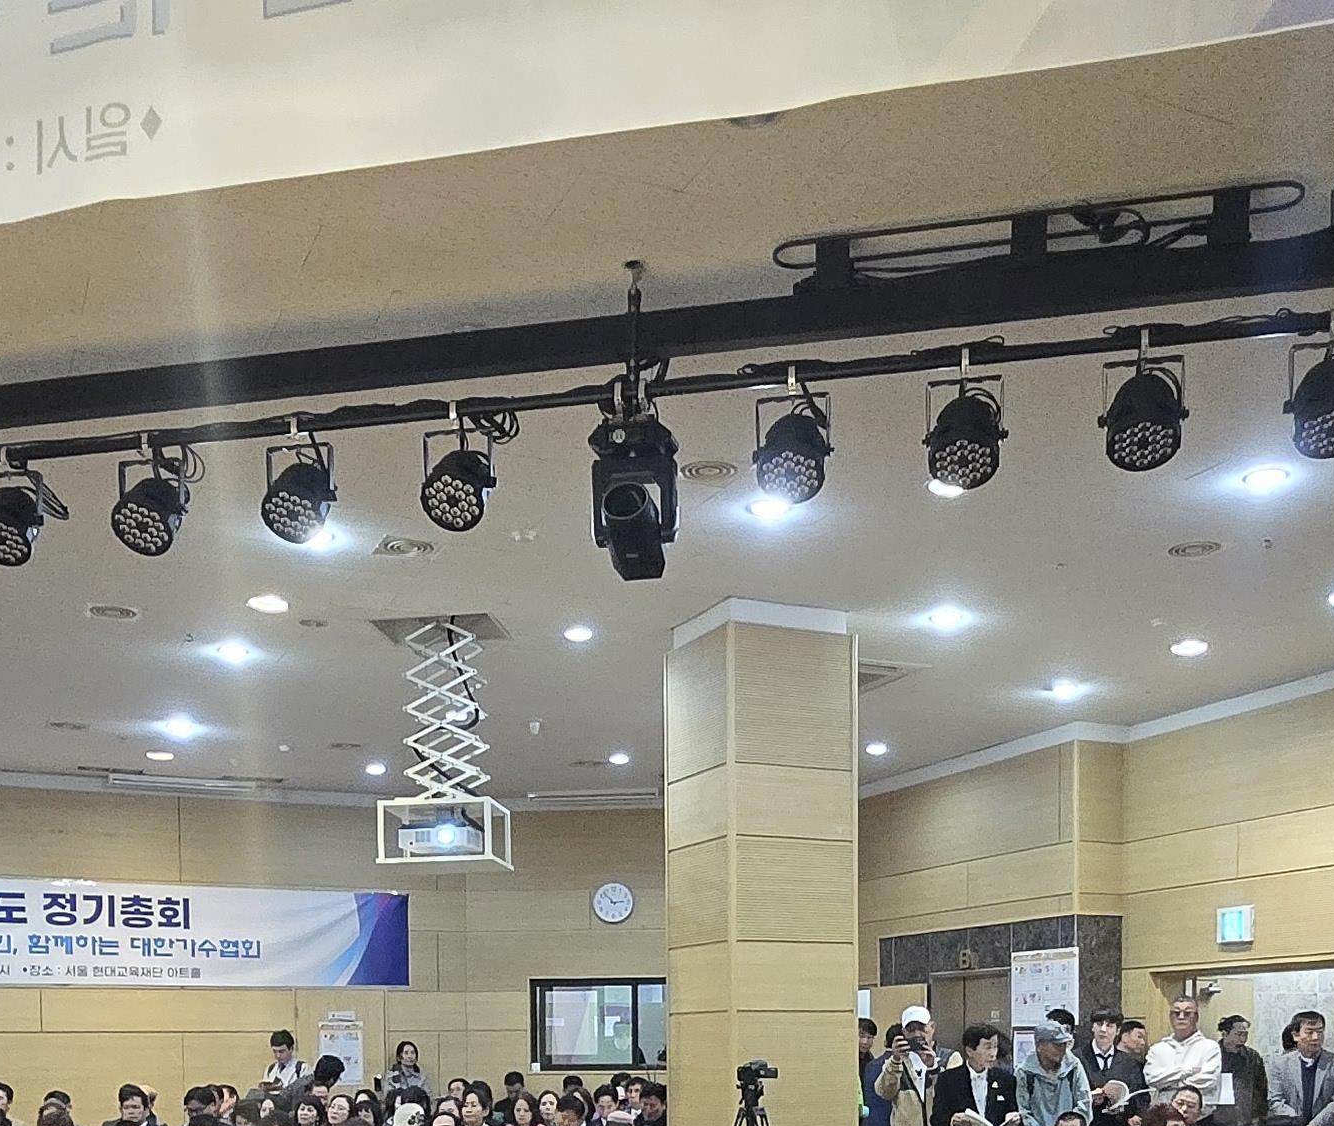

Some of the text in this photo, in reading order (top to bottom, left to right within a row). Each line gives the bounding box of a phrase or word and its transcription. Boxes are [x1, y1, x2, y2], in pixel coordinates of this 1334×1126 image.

[42, 892, 191, 930] 정기총회
[27, 933, 119, 957] 함께하는
[130, 937, 262, 960] 대한가수협회
[29, 964, 55, 977] 장소
[65, 965, 88, 977] 서울
[92, 966, 164, 978] 현대교육재단
